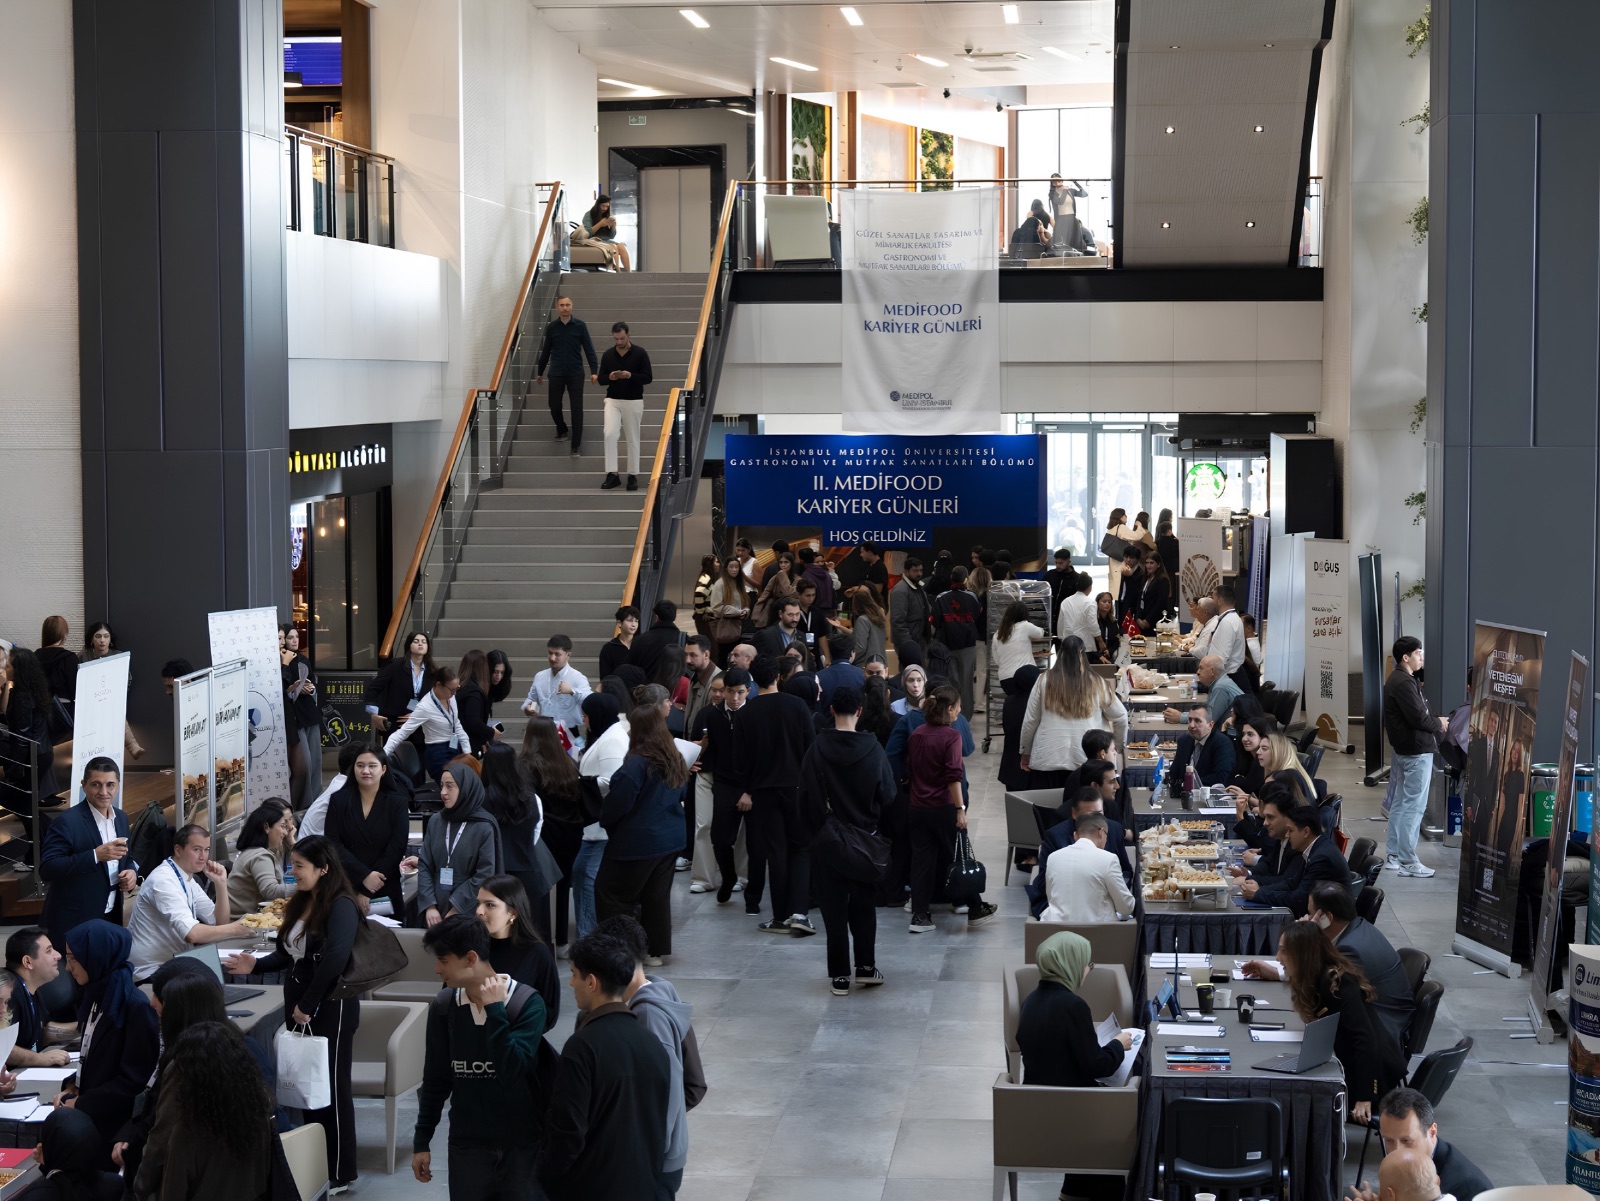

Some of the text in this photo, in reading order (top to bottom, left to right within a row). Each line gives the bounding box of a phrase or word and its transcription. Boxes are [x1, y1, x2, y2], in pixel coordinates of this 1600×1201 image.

[856, 229, 883, 238] GÜZEL
[886, 231, 931, 240] SANATLAR
[934, 230, 972, 239] TASARIM
[883, 253, 937, 262] GASTRONOMİ
[883, 302, 962, 317] MEDİFOOD
[864, 315, 982, 334] KARİYER GÜNLERİ
[769, 447, 994, 456] İSTANBUL MEDİPOL ÜNİVERSİTESİ
[730, 458, 815, 466] GASTRONOMİ
[981, 457, 1035, 466] BÖLÜMÜ
[813, 472, 943, 491] II. MEDİFOOD
[797, 495, 959, 514] KARİYER GÜNLERİ
[830, 528, 926, 544] HOŞ GELDİNİZ
